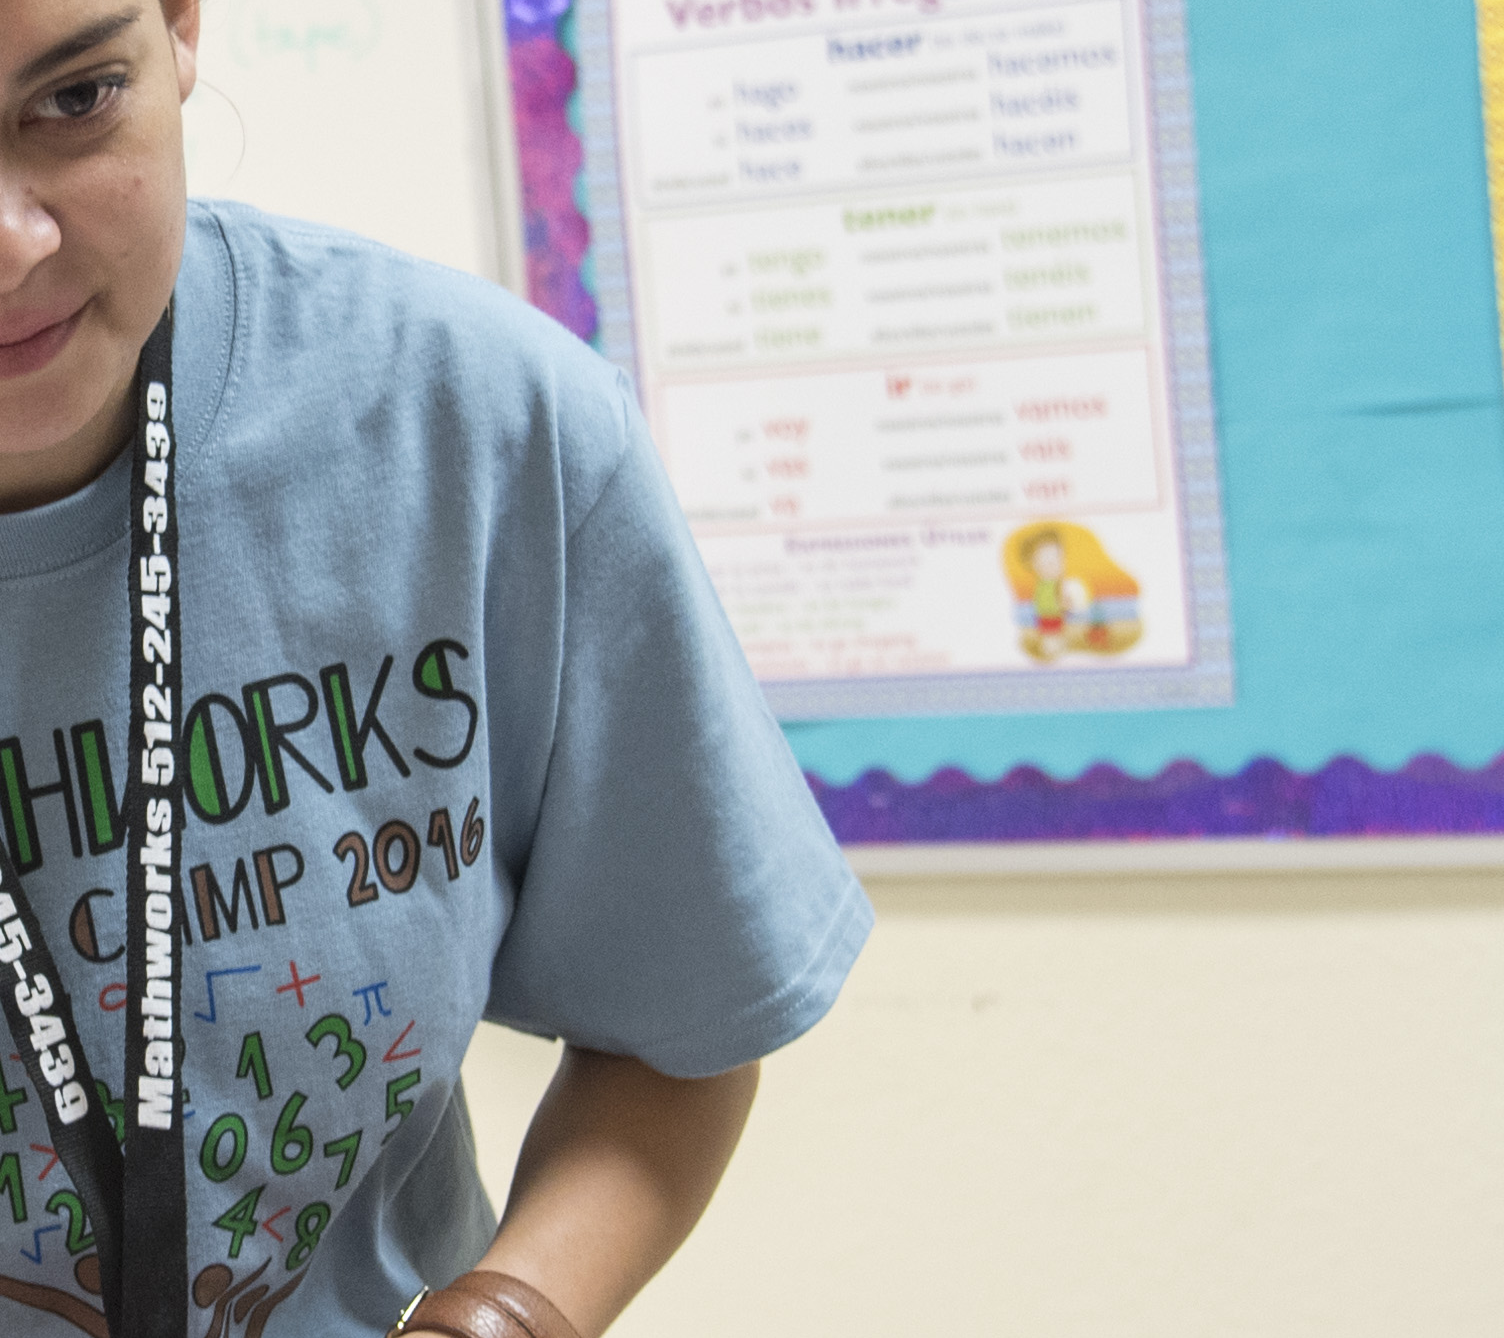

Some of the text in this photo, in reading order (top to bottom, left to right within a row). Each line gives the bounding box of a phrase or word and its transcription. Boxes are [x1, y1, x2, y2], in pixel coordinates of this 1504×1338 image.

[137, 381, 176, 1131] 512-245-3439 Mathworks
[68, 843, 306, 965] CMP
[333, 796, 486, 909] 2016
[305, 1012, 367, 1090] 3
